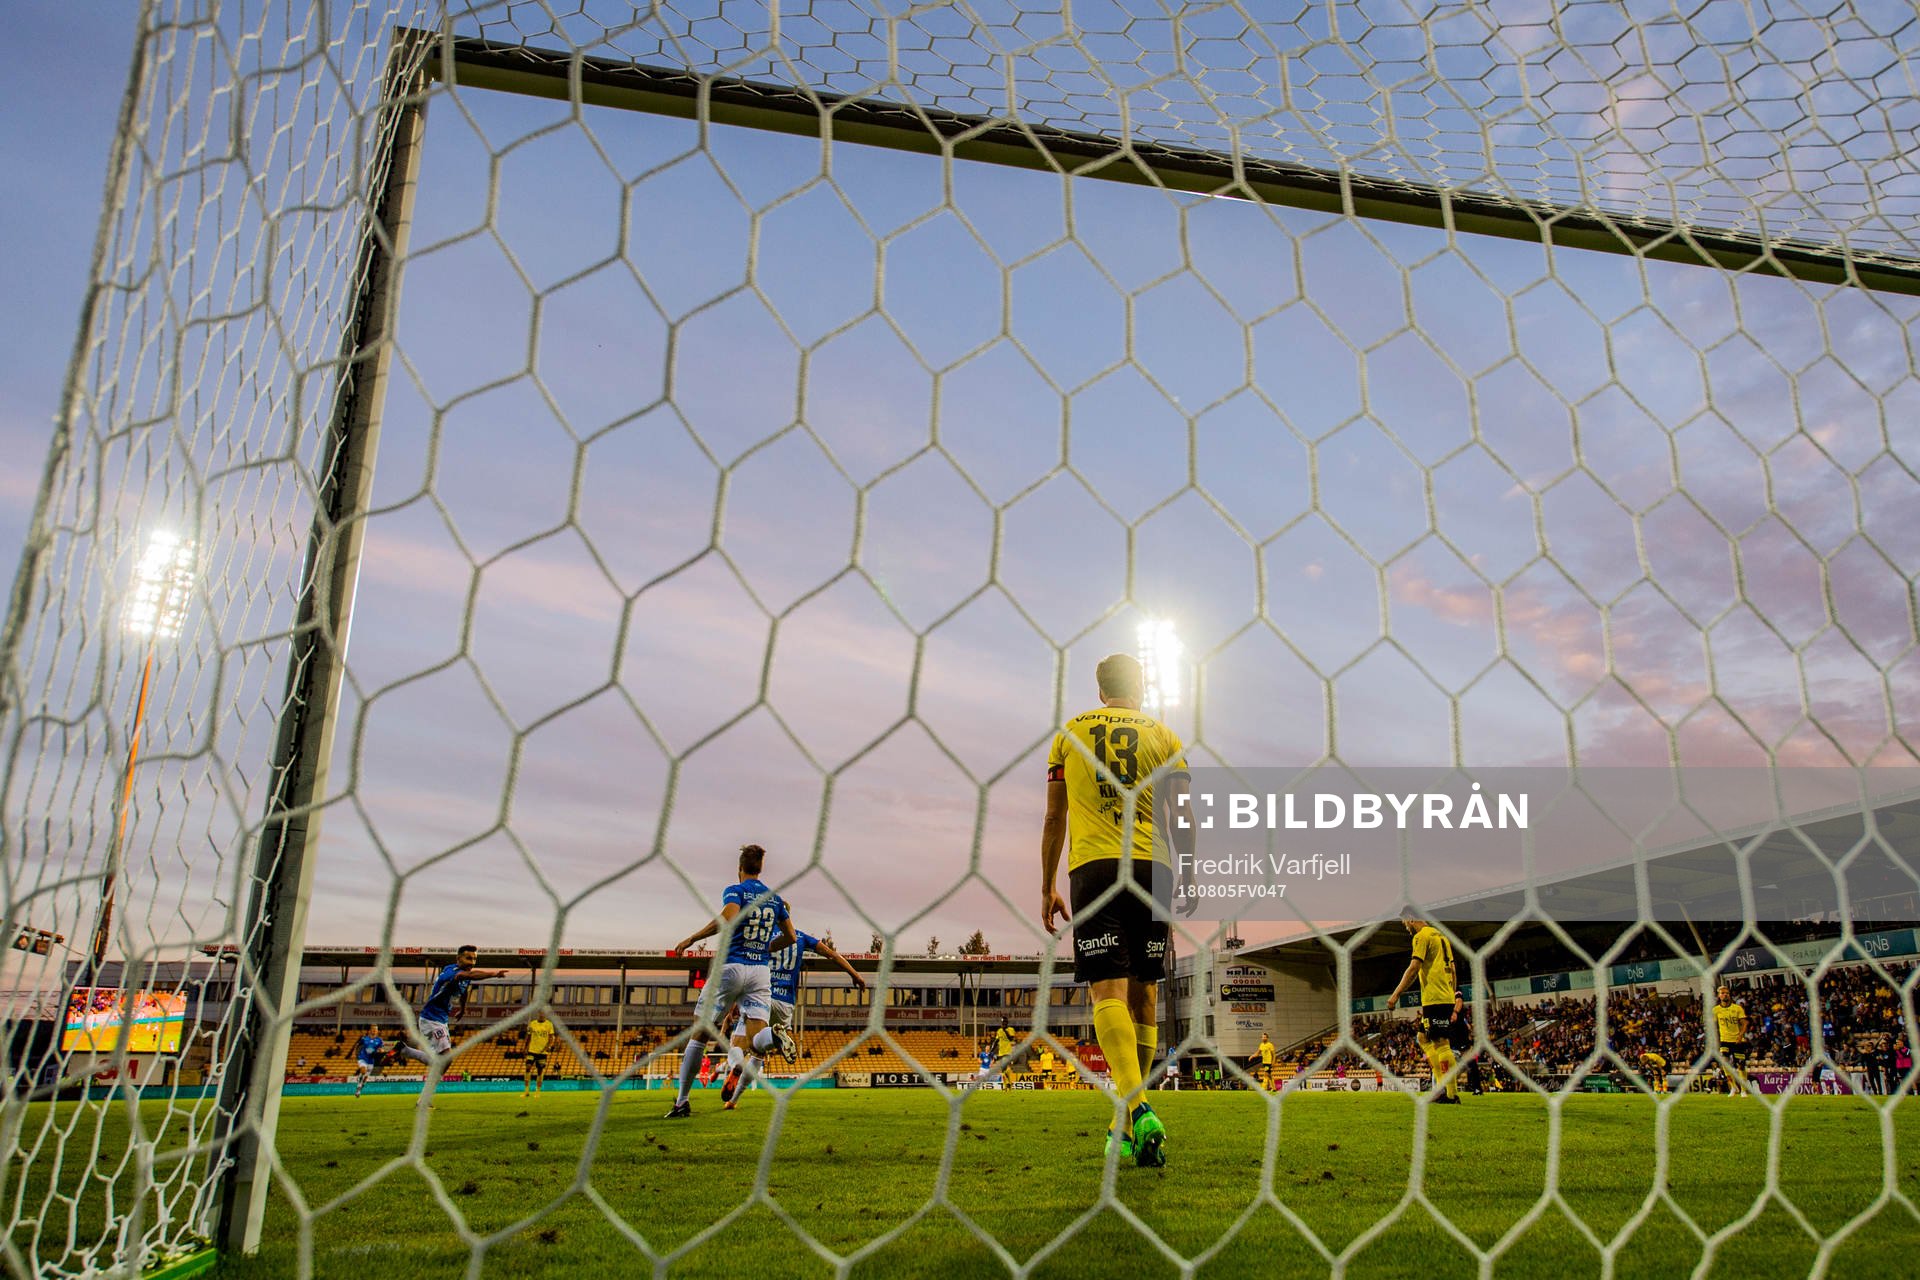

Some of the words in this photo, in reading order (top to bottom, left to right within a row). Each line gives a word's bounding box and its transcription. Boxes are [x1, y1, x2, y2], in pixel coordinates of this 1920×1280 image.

[1089, 723, 1139, 784] 13
[1113, 811, 1143, 825] MT
[743, 906, 775, 942] 33
[1077, 933, 1120, 951] Scandic
[1864, 934, 1890, 956] DNB
[768, 943, 798, 971] 30
[1735, 952, 1756, 970] DNB
[1627, 965, 1645, 982] DNB
[1543, 976, 1557, 991] DNB
